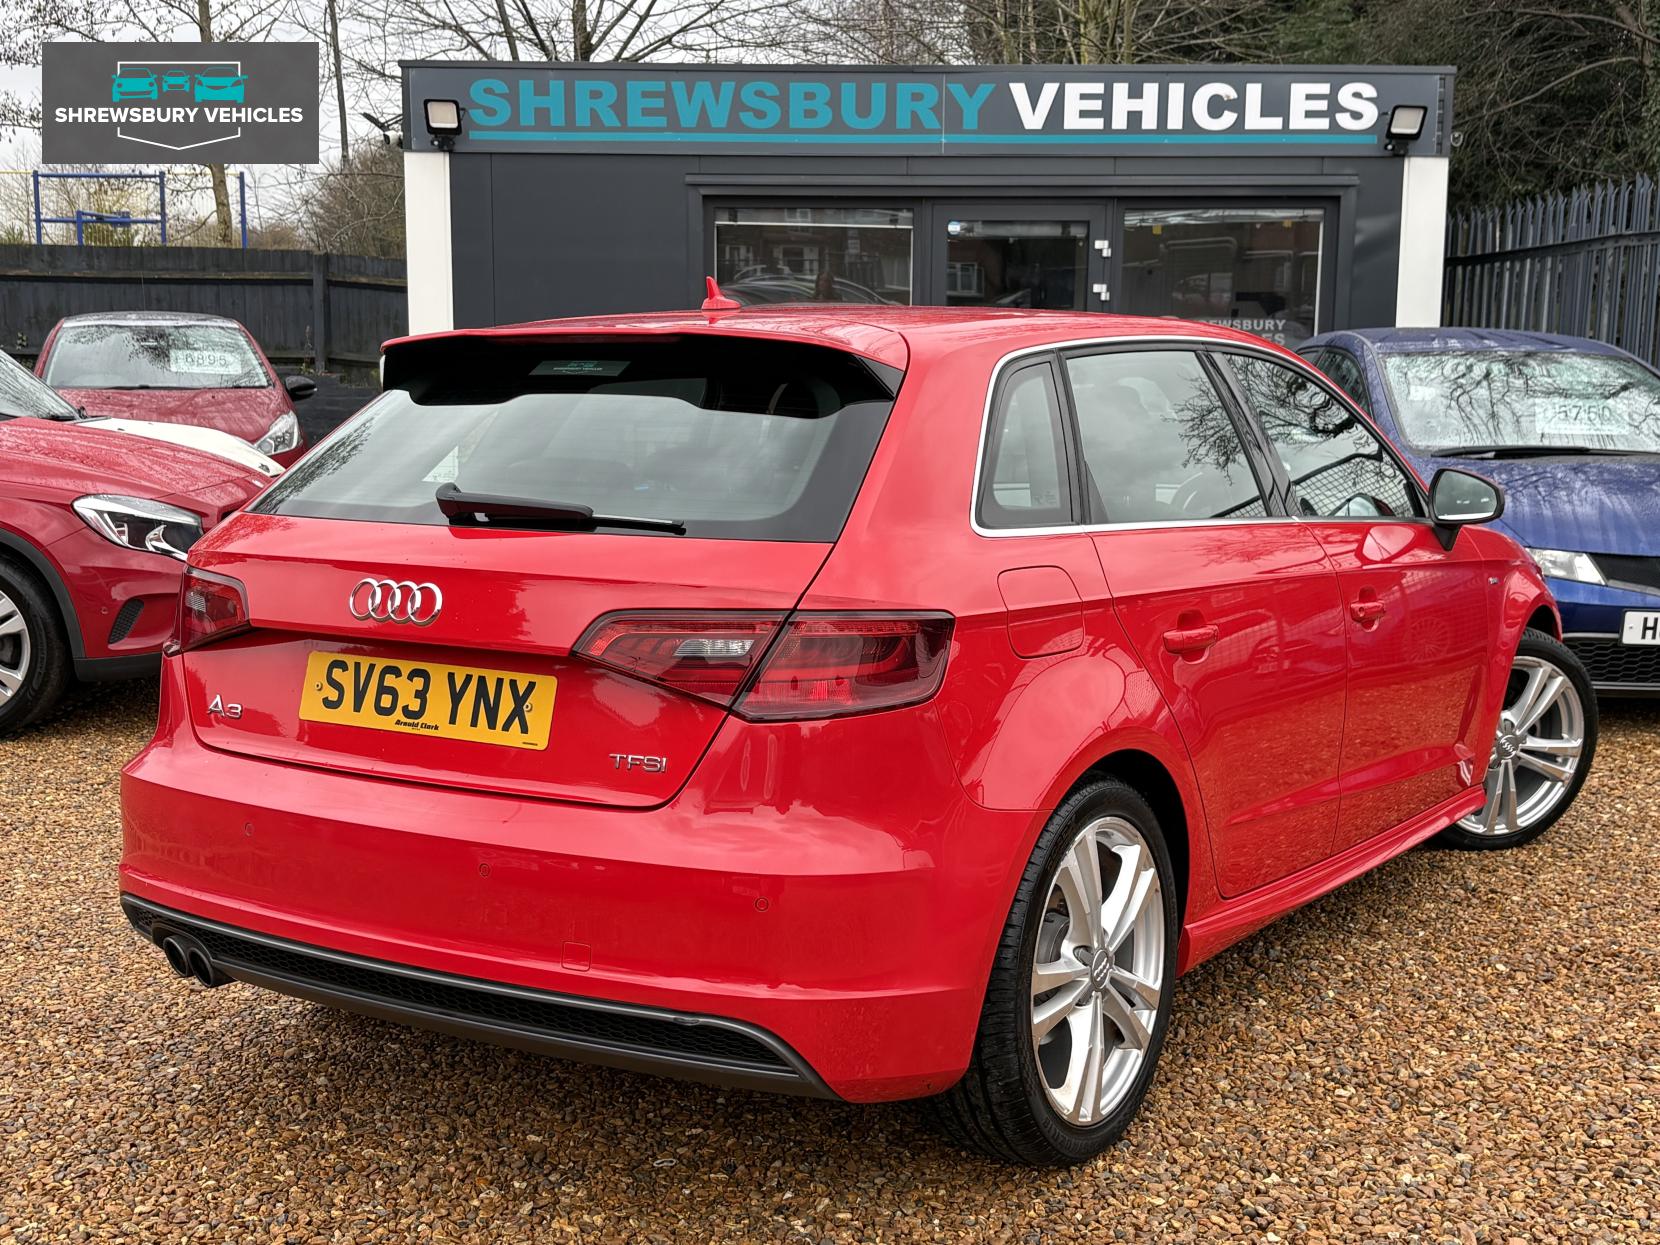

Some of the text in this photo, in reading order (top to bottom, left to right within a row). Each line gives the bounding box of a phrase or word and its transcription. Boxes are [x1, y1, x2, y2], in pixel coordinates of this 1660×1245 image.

[468, 78, 1380, 132] SHREWSBURY VEHICLES
[1641, 616, 1660, 640] H
[207, 693, 243, 719] A3
[321, 658, 537, 735] SV63 YNX
[395, 718, 420, 728] Arnold
[420, 722, 440, 731] Clark
[608, 753, 667, 773] TFSI
